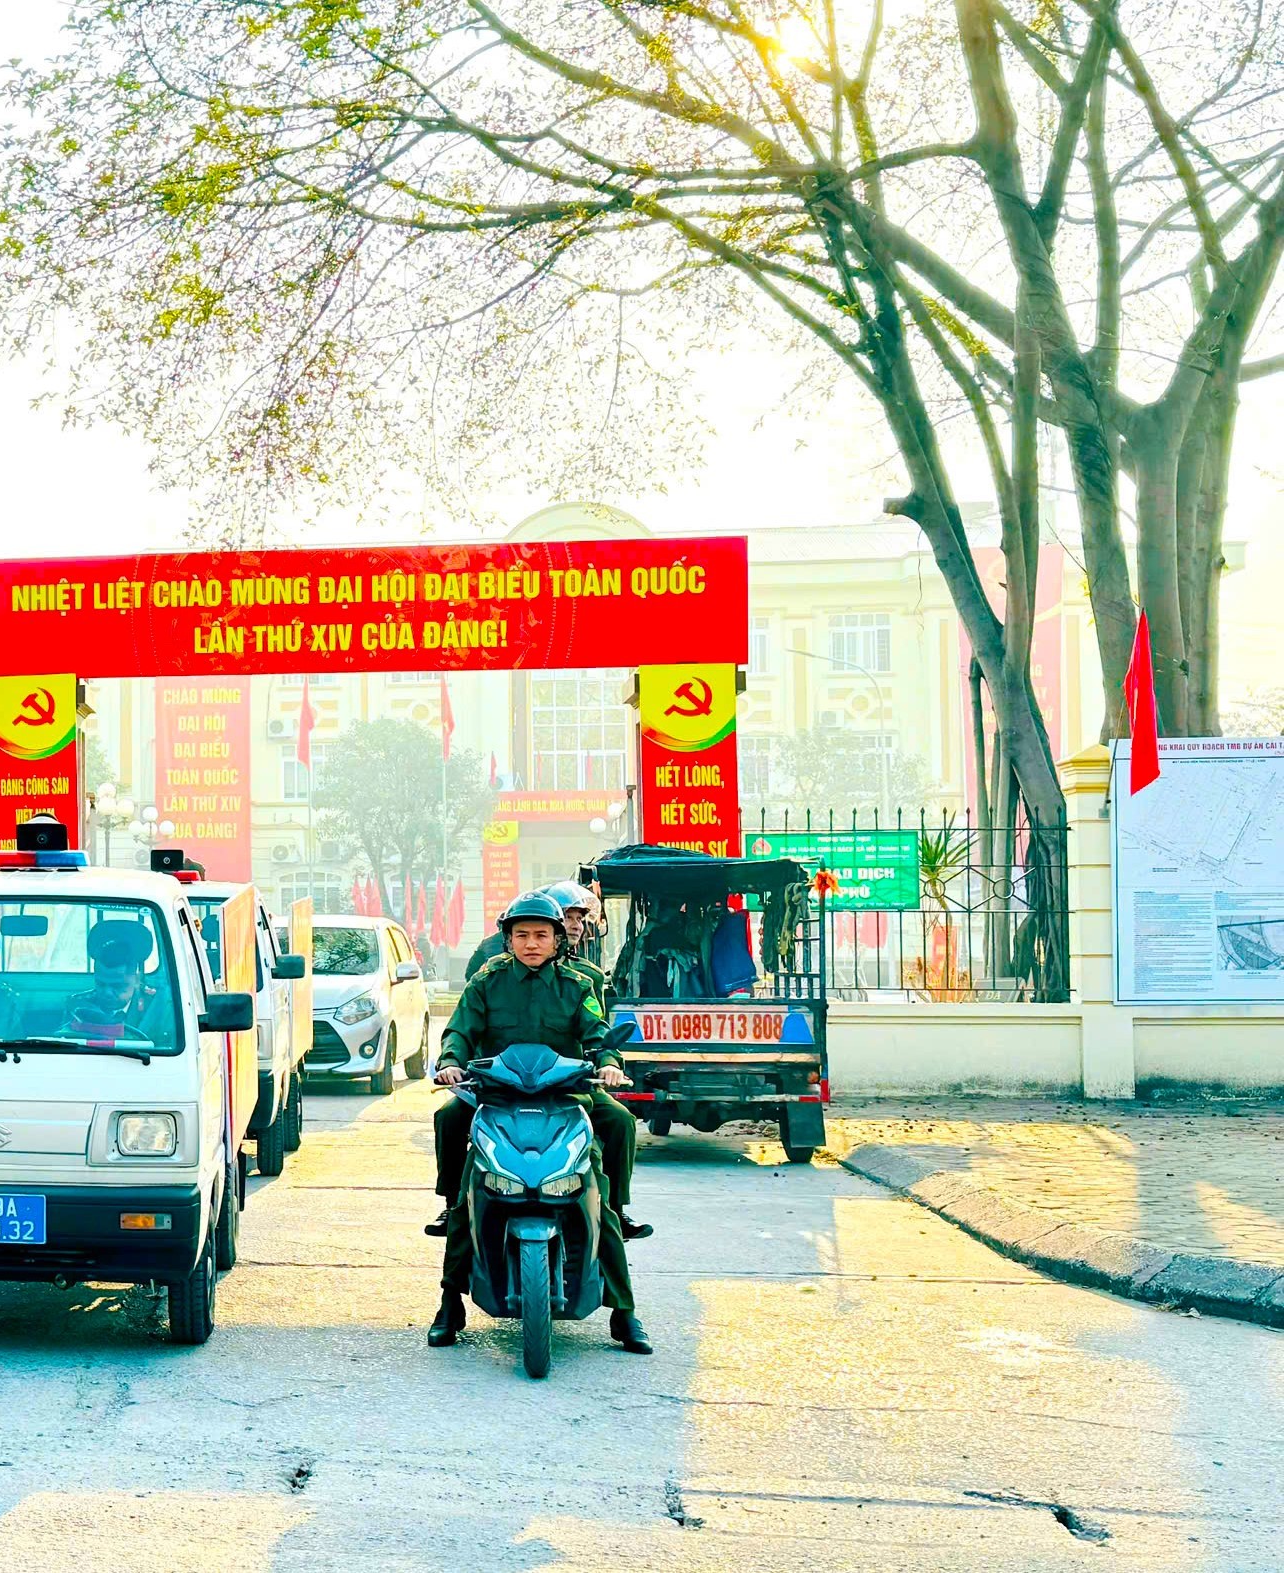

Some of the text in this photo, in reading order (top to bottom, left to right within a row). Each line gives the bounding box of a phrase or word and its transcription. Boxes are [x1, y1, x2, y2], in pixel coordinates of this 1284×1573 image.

[12, 556, 706, 616] NHIỆT LIỆT CHÀO MỪNG ĐẠI HỘI ĐẠI BIỂU TOÀN QUỐC
[194, 611, 508, 654] LẦN THỨ XIV CỦA ĐẢNG!
[0, 772, 70, 799] ĐẢNG CỘNG SẢN
[656, 758, 725, 789] HẾT LÒNG,
[660, 797, 686, 825] HẾT
[689, 799, 722, 826] SỨC,
[643, 1013, 783, 1040] ĐT: 0989 713 808
